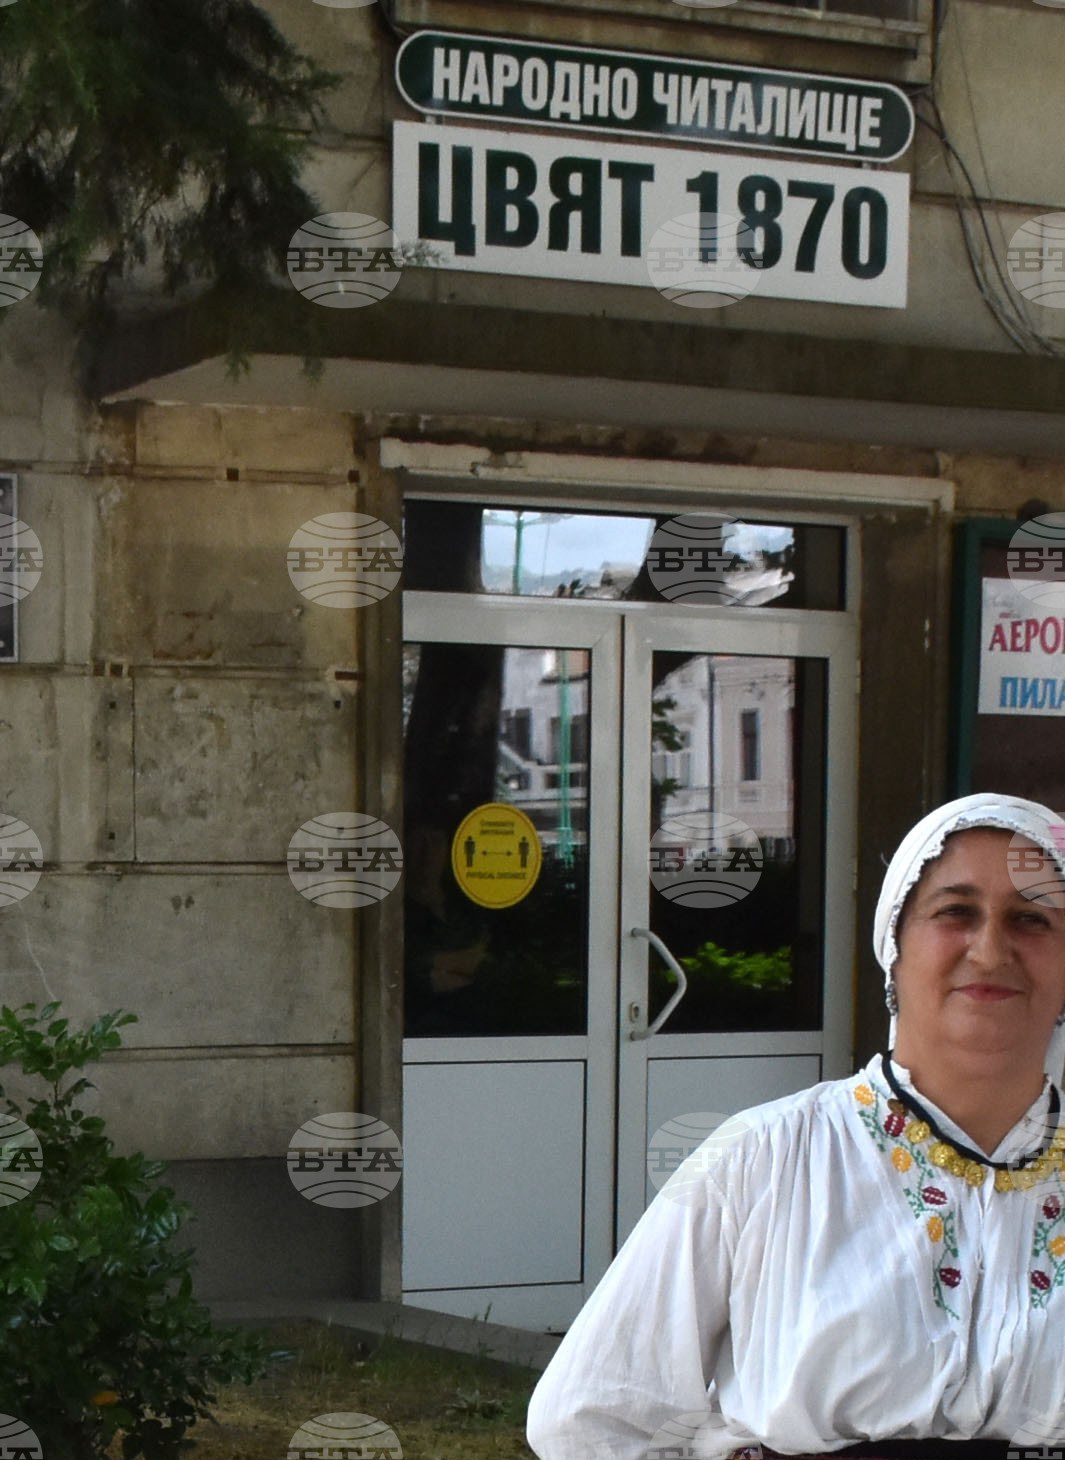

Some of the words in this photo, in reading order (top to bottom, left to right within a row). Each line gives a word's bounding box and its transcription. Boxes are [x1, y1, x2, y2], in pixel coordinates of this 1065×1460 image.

[432, 46, 639, 122] НАРОДНО
[652, 72, 883, 152] ЧИТАЛИЩЕ
[417, 141, 655, 258] ЦВЯТ
[686, 170, 889, 280] 1870
